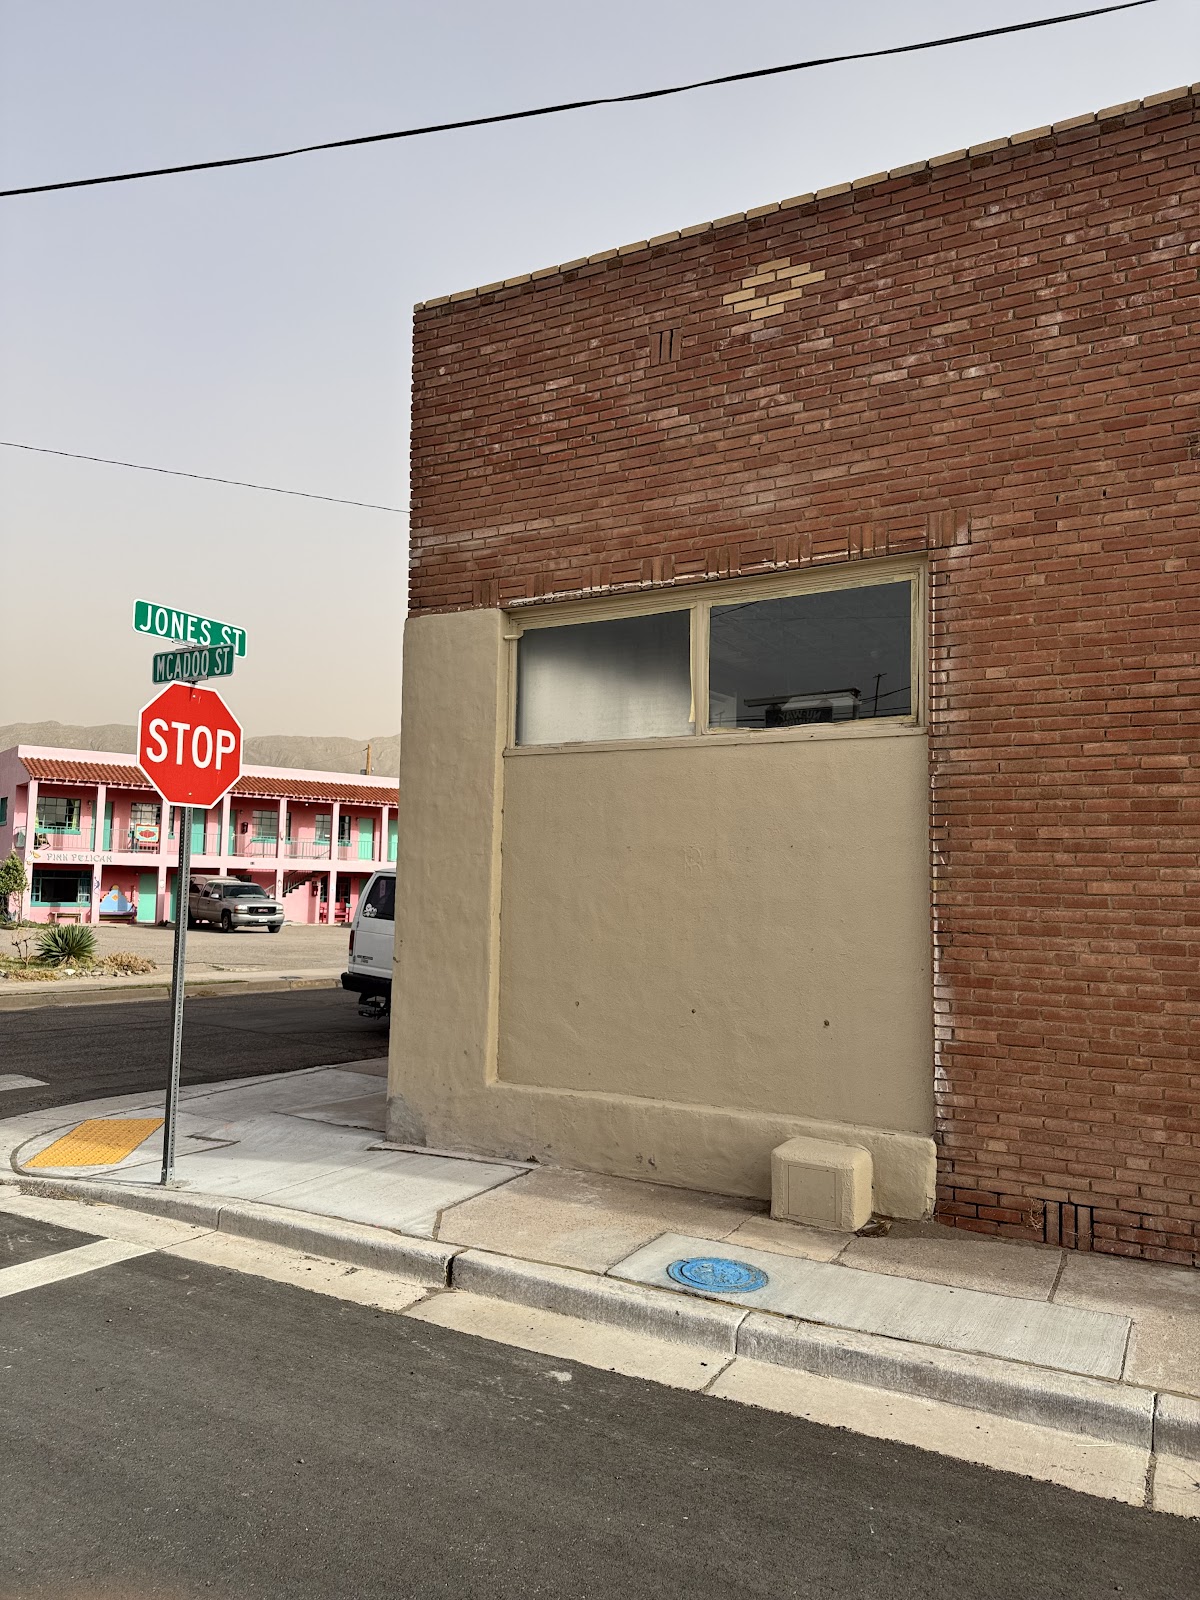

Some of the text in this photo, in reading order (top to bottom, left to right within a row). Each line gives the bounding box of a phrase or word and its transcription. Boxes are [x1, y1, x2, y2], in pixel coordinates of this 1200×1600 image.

[139, 604, 243, 655] JONES ST
[156, 647, 231, 682] MCADOO ST
[146, 717, 236, 771] STOP
[46, 852, 113, 863] PINK PELICAN
